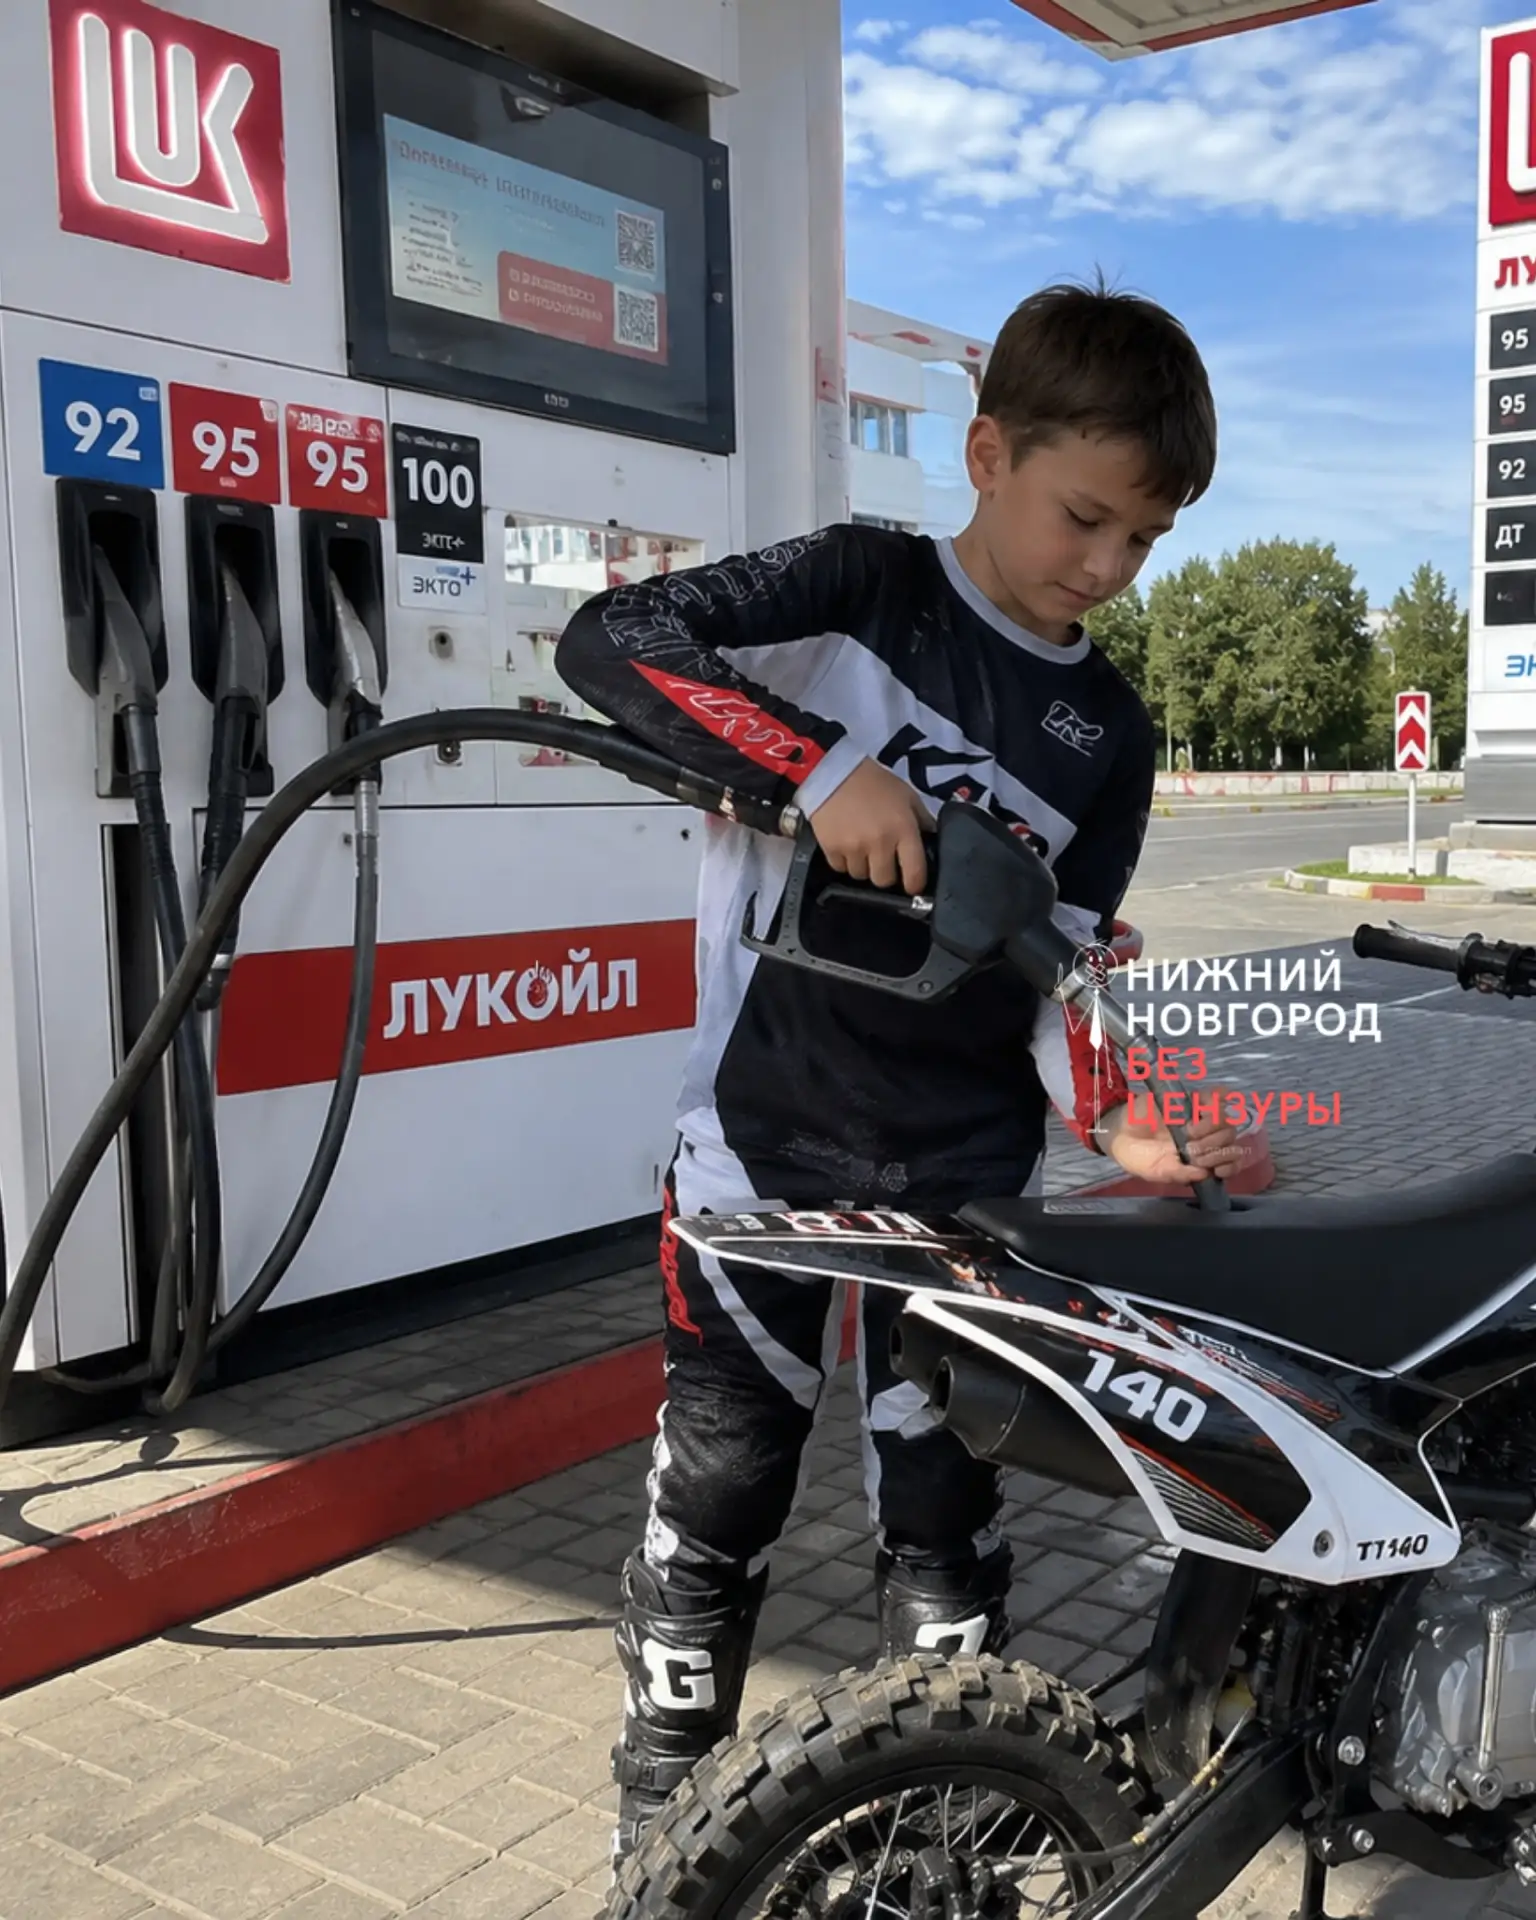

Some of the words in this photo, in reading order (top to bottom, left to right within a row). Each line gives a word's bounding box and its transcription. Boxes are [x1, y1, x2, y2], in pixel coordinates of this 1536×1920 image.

[1501, 328, 1529, 351] 95
[1499, 393, 1526, 416] 95
[65, 400, 141, 462] 92
[192, 421, 260, 478] 95
[306, 440, 369, 493] 95
[402, 457, 475, 509] 100
[1498, 458, 1526, 480] 92
[1494, 523, 1526, 550] ДТ
[382, 947, 638, 1040] ЛУКОЙЛ
[1083, 1349, 1208, 1443] 140
[1356, 1533, 1429, 1561] TT140
